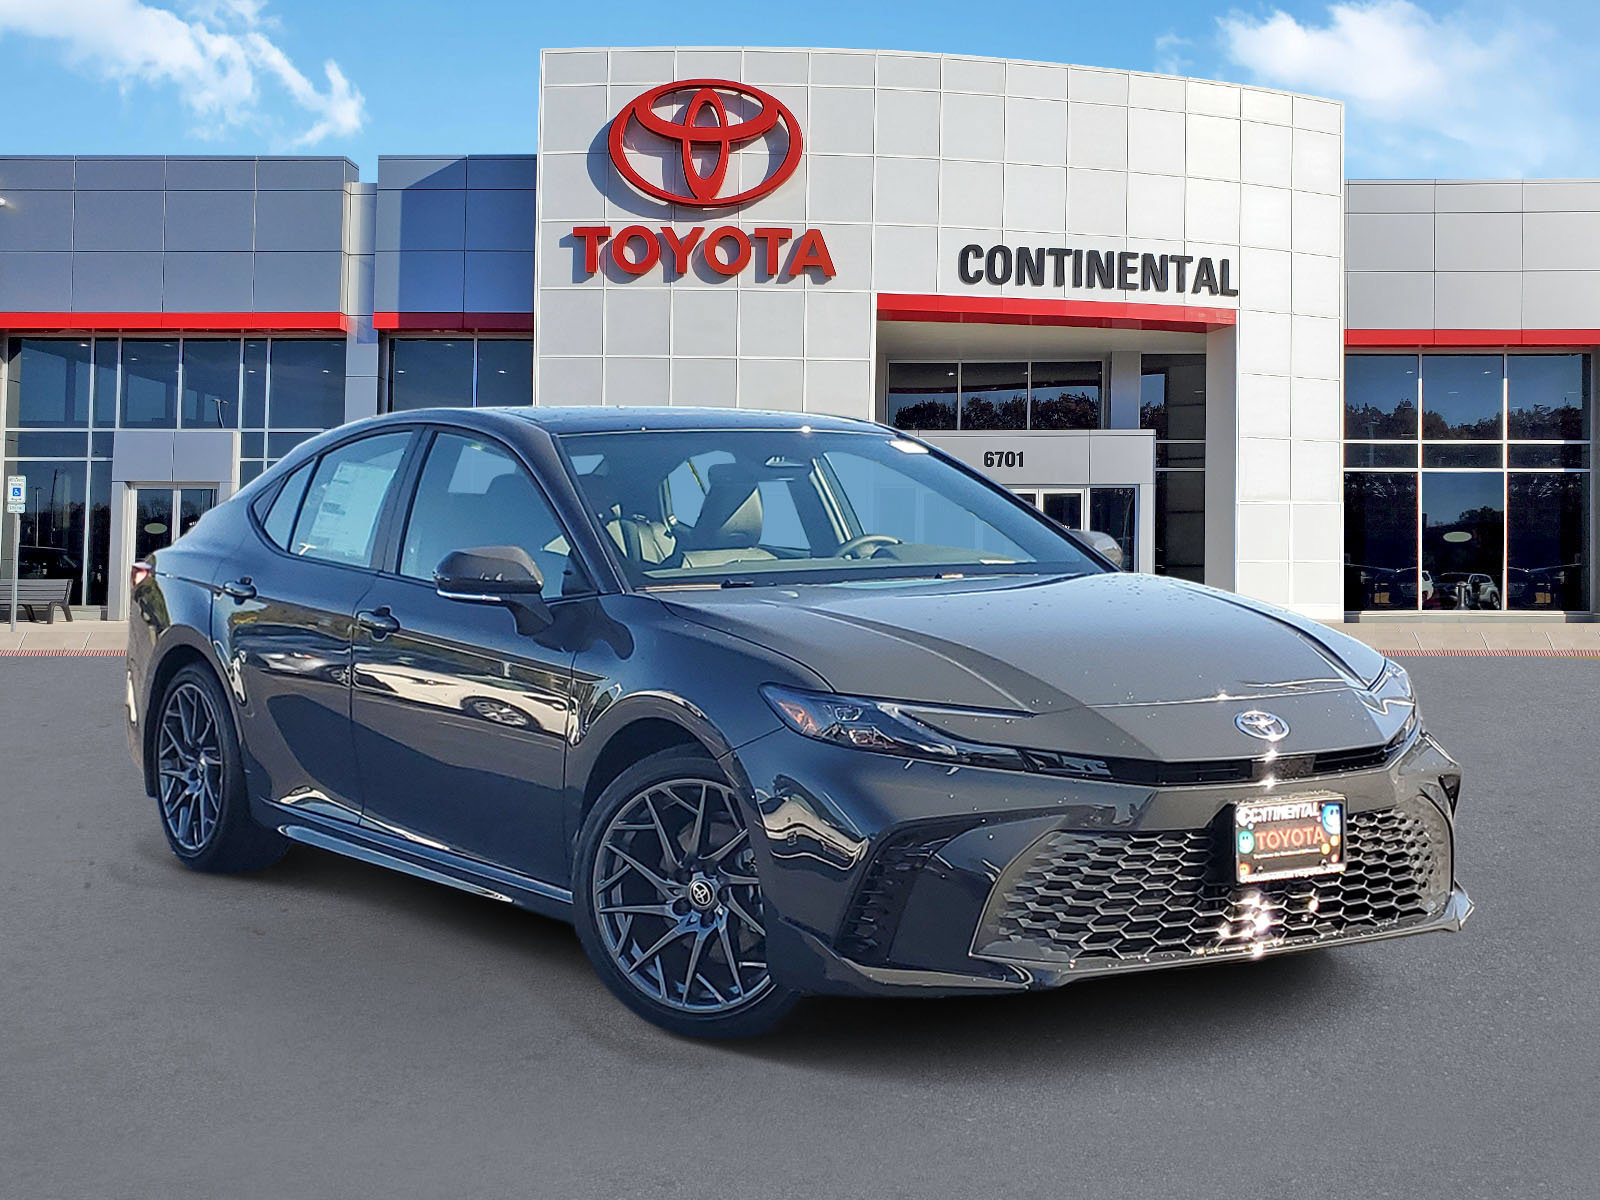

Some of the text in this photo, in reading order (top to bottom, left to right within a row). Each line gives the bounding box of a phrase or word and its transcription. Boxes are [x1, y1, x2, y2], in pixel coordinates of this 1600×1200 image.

[572, 225, 837, 277] TOYOTA
[958, 244, 1239, 296] CONTINENTAL
[983, 451, 1024, 468] 6701
[1237, 802, 1320, 826] CONTINENTAL
[1256, 827, 1326, 849] TOYOTA
